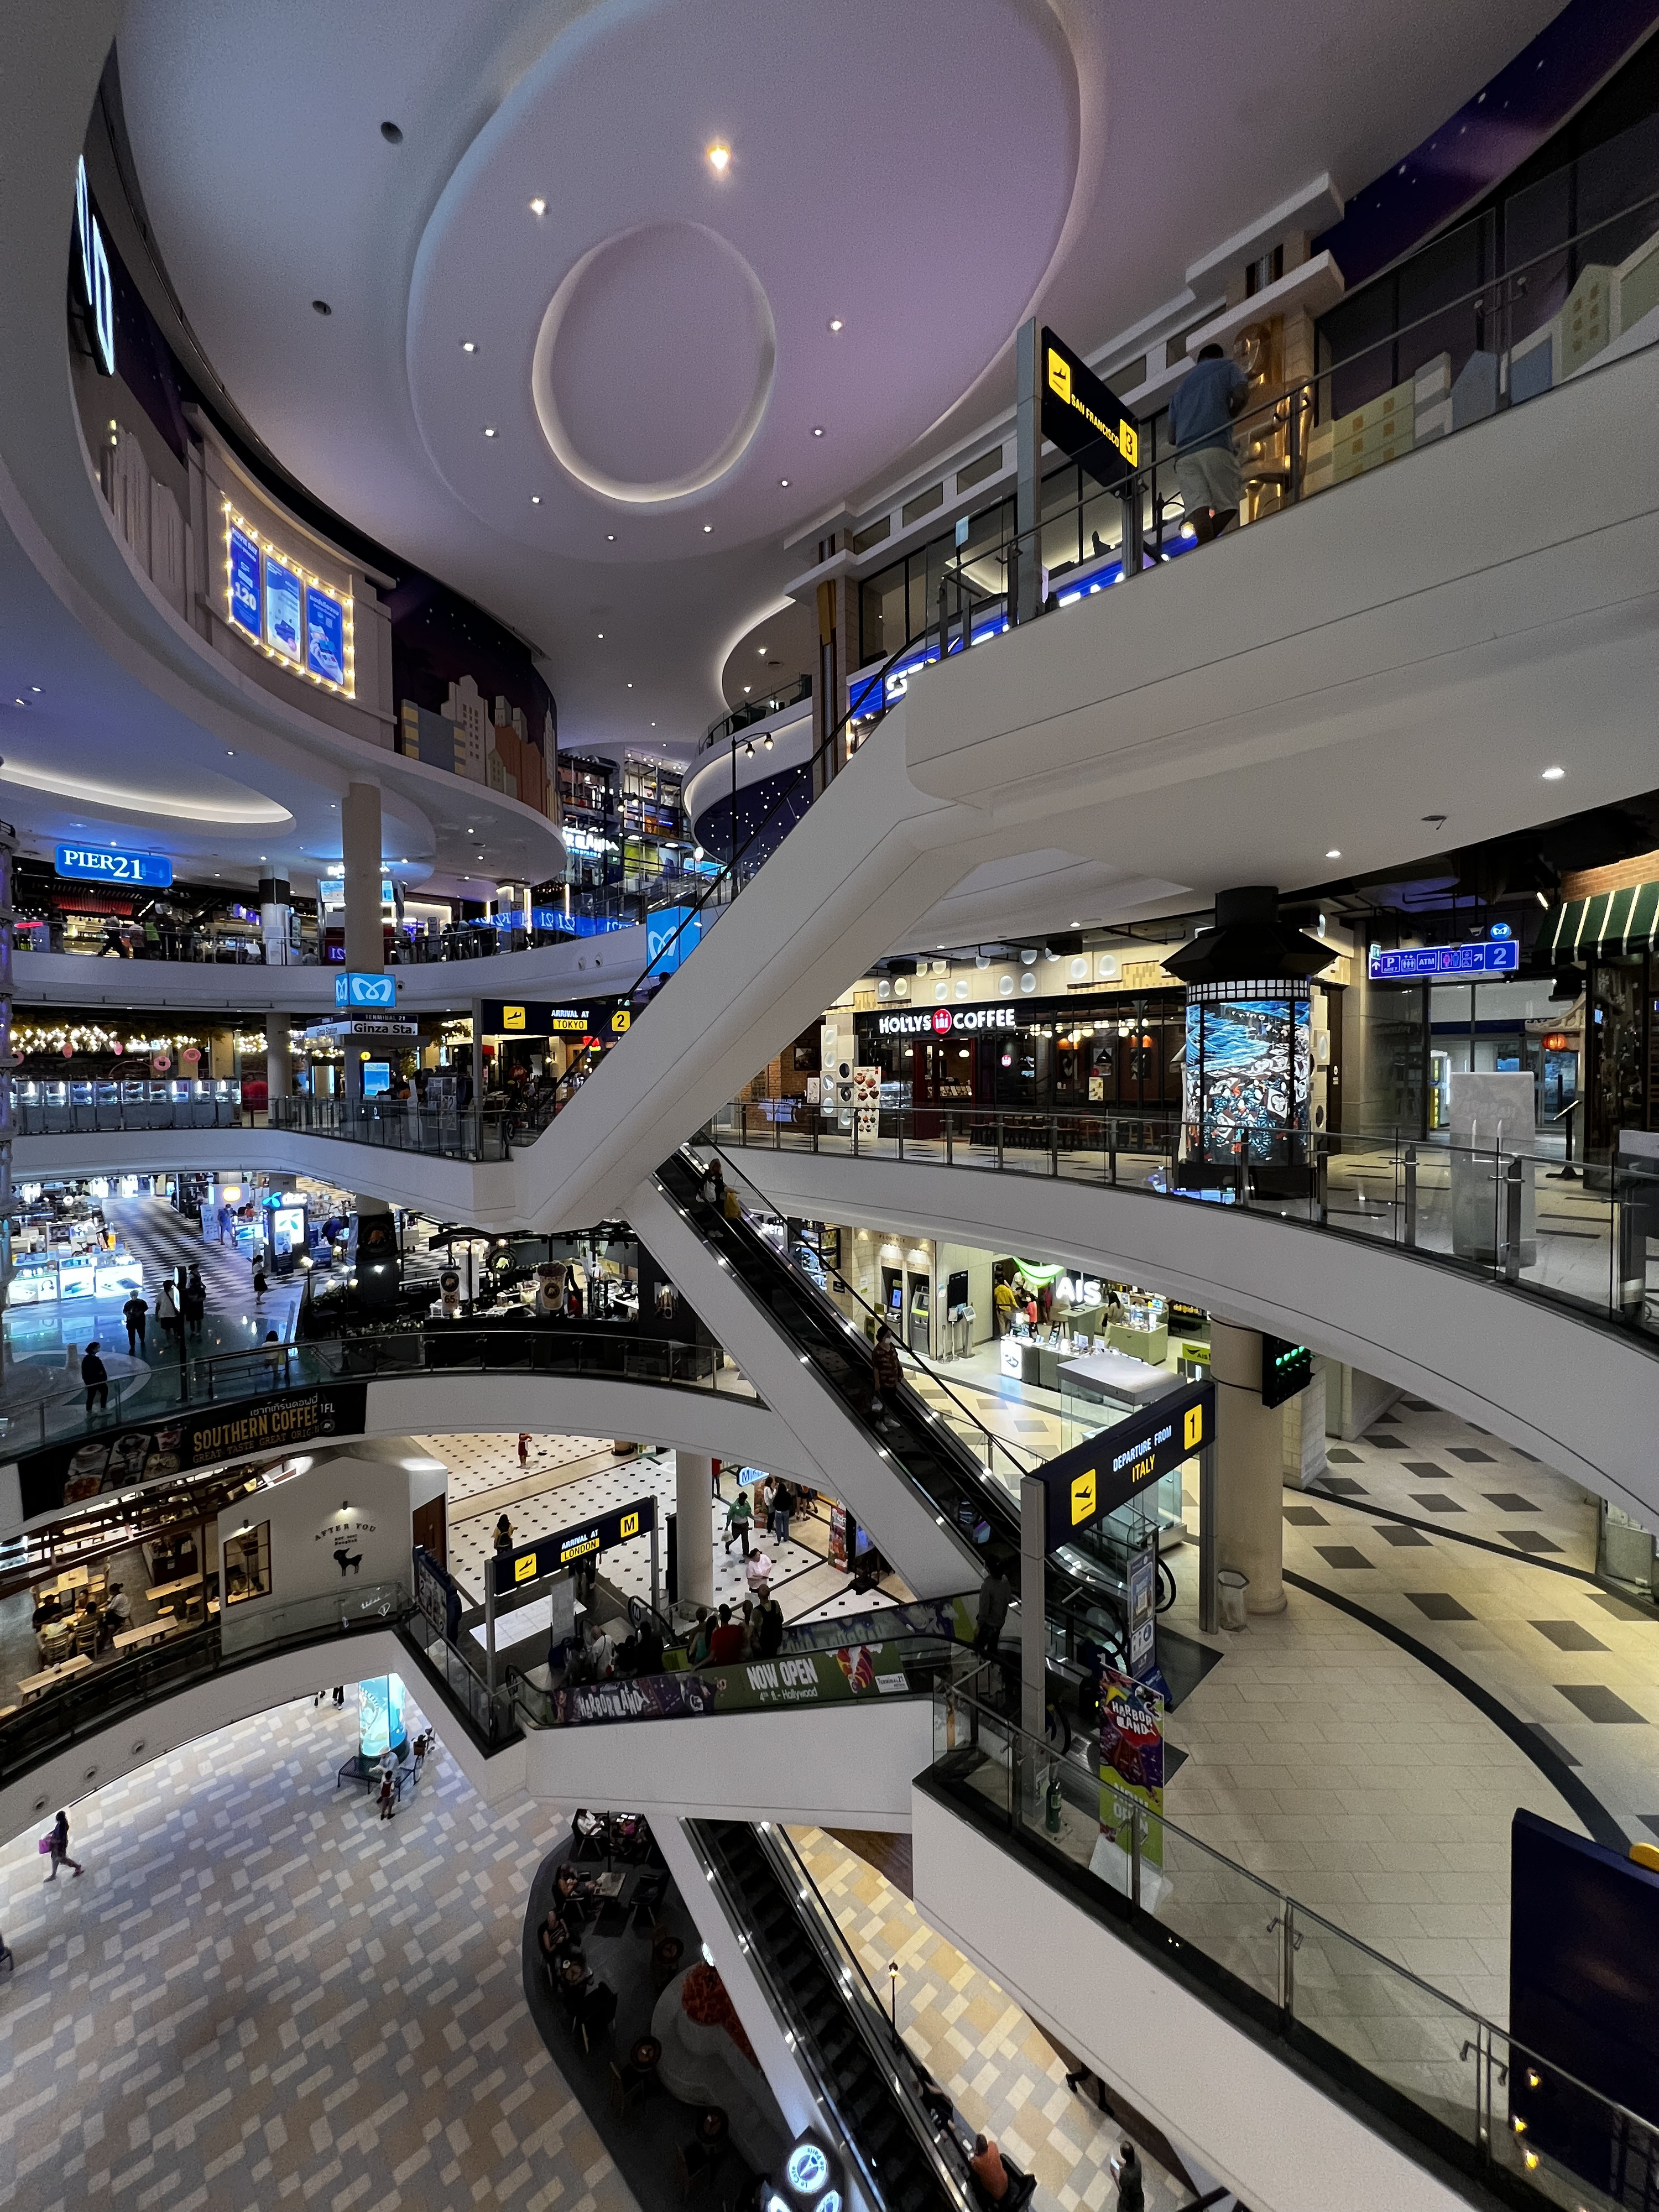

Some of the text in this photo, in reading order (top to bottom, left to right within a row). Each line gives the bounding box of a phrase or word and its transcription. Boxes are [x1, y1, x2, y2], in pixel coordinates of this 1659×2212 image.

[1071, 394, 1120, 447] SAN FRANCISCO
[1126, 431, 1133, 456] 3
[234, 581, 257, 611] 120
[1387, 957, 1395, 968] P
[1493, 947, 1507, 965] 2
[353, 1023, 416, 1035] Ginza Sta.
[557, 1020, 584, 1029] TOKYO
[616, 1014, 625, 1027] 2
[879, 1008, 1016, 1034] HOLLYS COFFEE
[444, 1294, 456, 1304] 65
[1056, 1276, 1102, 1306] AIS
[194, 1404, 318, 1452] SOUTHERN COFFEE
[1190, 1417, 1195, 1439] 1
[192, 1425, 320, 1464] GREAT TASTE GREAT ORIGIN
[1113, 1425, 1172, 1473] DEPARTURE FROM
[742, 1469, 750, 1483] M
[1132, 1453, 1156, 1483] ITALY
[315, 1522, 377, 1542] AFTER YOU
[624, 1516, 635, 1533] M
[561, 1529, 599, 1550] ARRIVAL AT
[564, 1540, 597, 1561] LONDON
[746, 1657, 818, 1690] NOW OPEN
[781, 1686, 818, 1700] Hollywood
[1112, 1700, 1153, 1728] HARBOR
